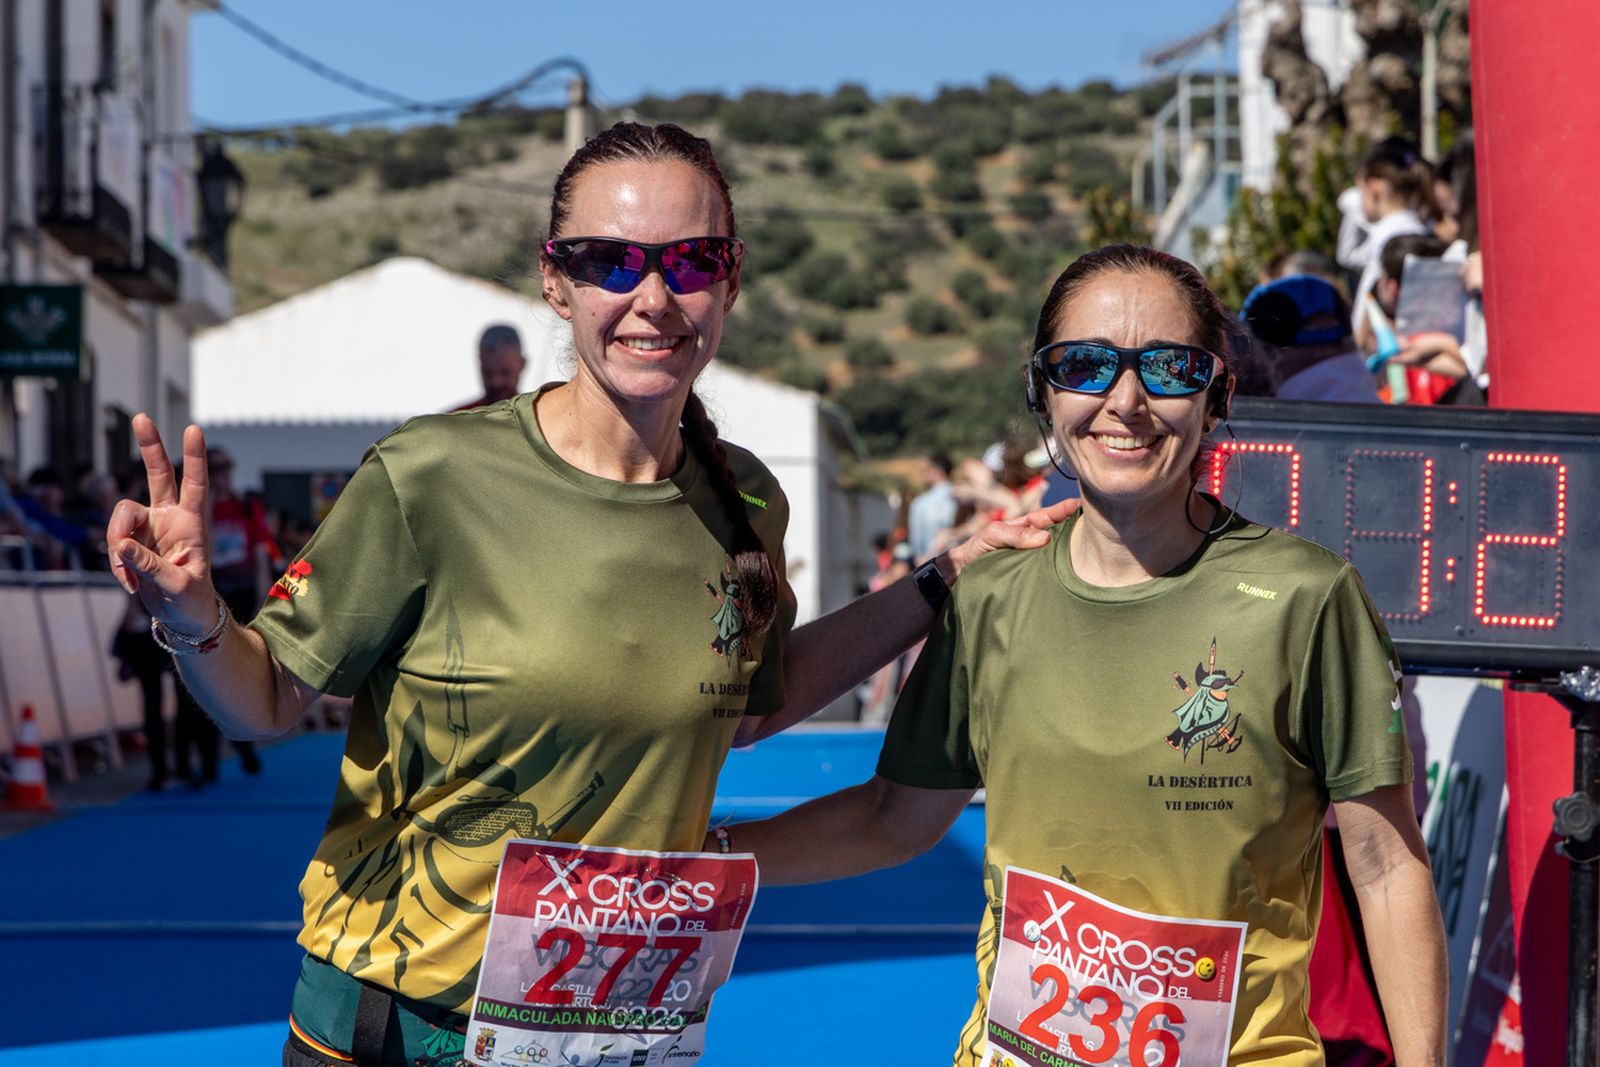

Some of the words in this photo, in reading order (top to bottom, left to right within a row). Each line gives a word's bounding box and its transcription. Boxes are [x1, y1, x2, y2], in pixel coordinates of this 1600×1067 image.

[1236, 582, 1277, 600] RUNNEK
[699, 682, 715, 695] LA
[1148, 775, 1165, 788] LA
[1169, 774, 1252, 788] DESÉRTICA
[1165, 801, 1182, 811] VII
[1185, 799, 1233, 811] EDICIÓN
[537, 855, 585, 900] X
[588, 874, 716, 912] CROSS
[533, 900, 681, 937] PANTANO
[685, 920, 708, 932] DEL
[1040, 890, 1076, 942] X
[1077, 923, 1197, 978] CROSS
[523, 927, 702, 1008] 277
[1031, 935, 1164, 1001] PANTANO
[1168, 985, 1192, 1000] DEL
[477, 1001, 581, 1025] INMACULADA
[1018, 963, 1185, 1067] 236
[988, 1023, 1019, 1048] MARIA
[1020, 1039, 1038, 1059] DEL
